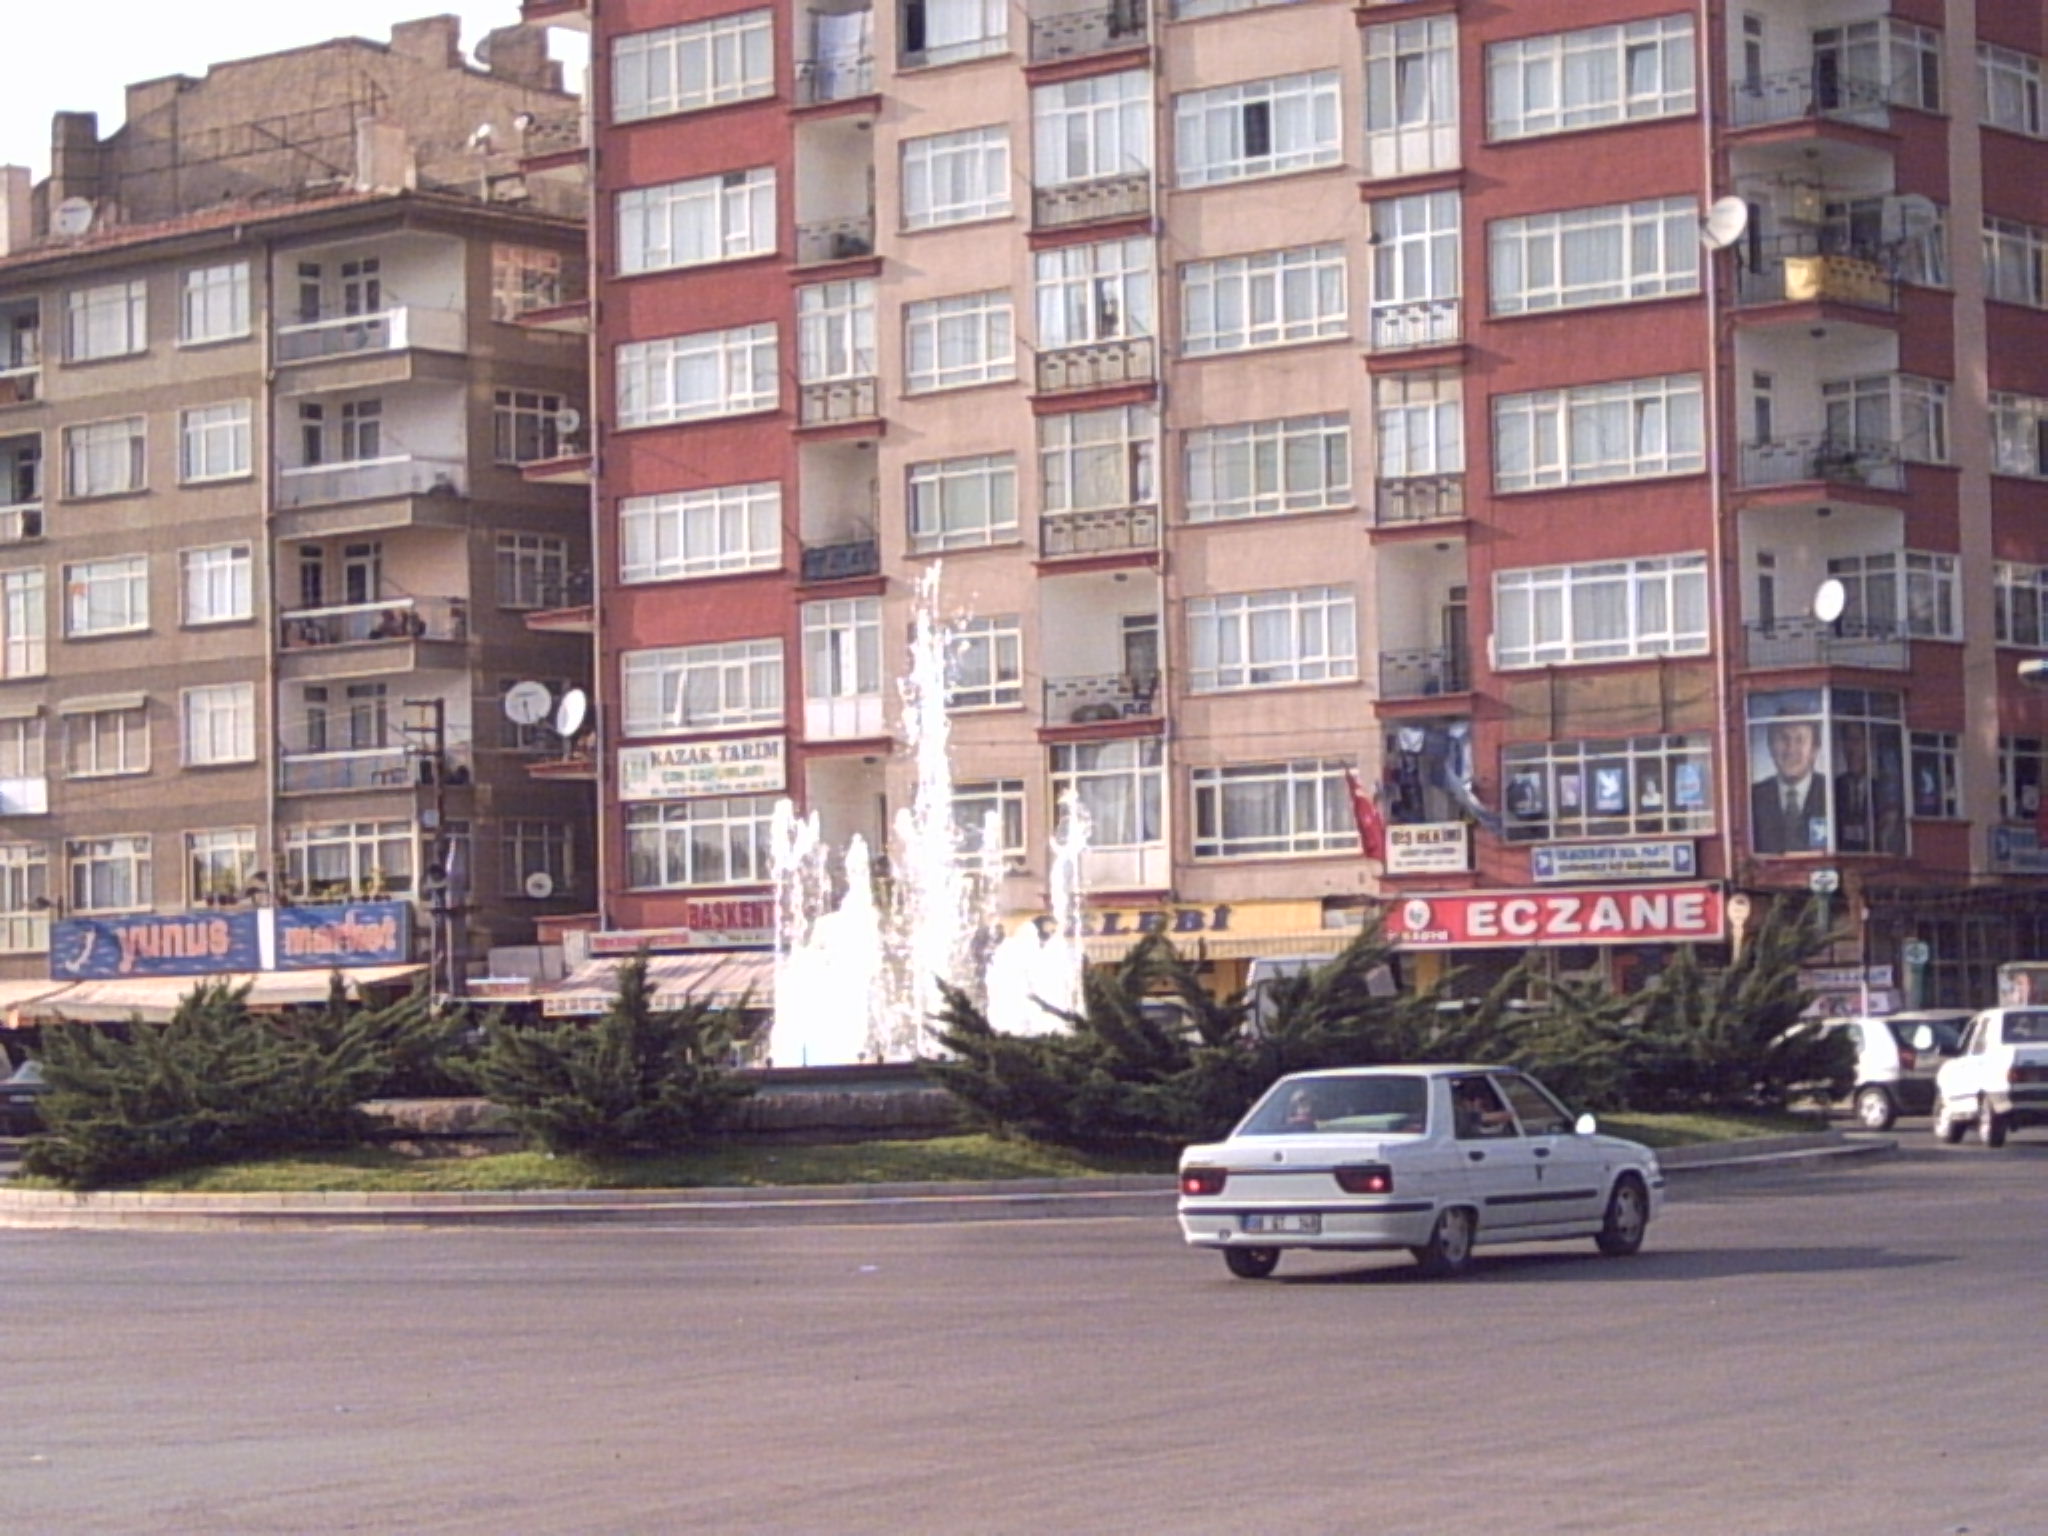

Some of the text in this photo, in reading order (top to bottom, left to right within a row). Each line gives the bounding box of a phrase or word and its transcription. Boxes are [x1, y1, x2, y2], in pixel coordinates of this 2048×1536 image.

[651, 747, 712, 767] KAZAK
[1466, 893, 1708, 938] ECZANE
[116, 918, 231, 973] yunus
